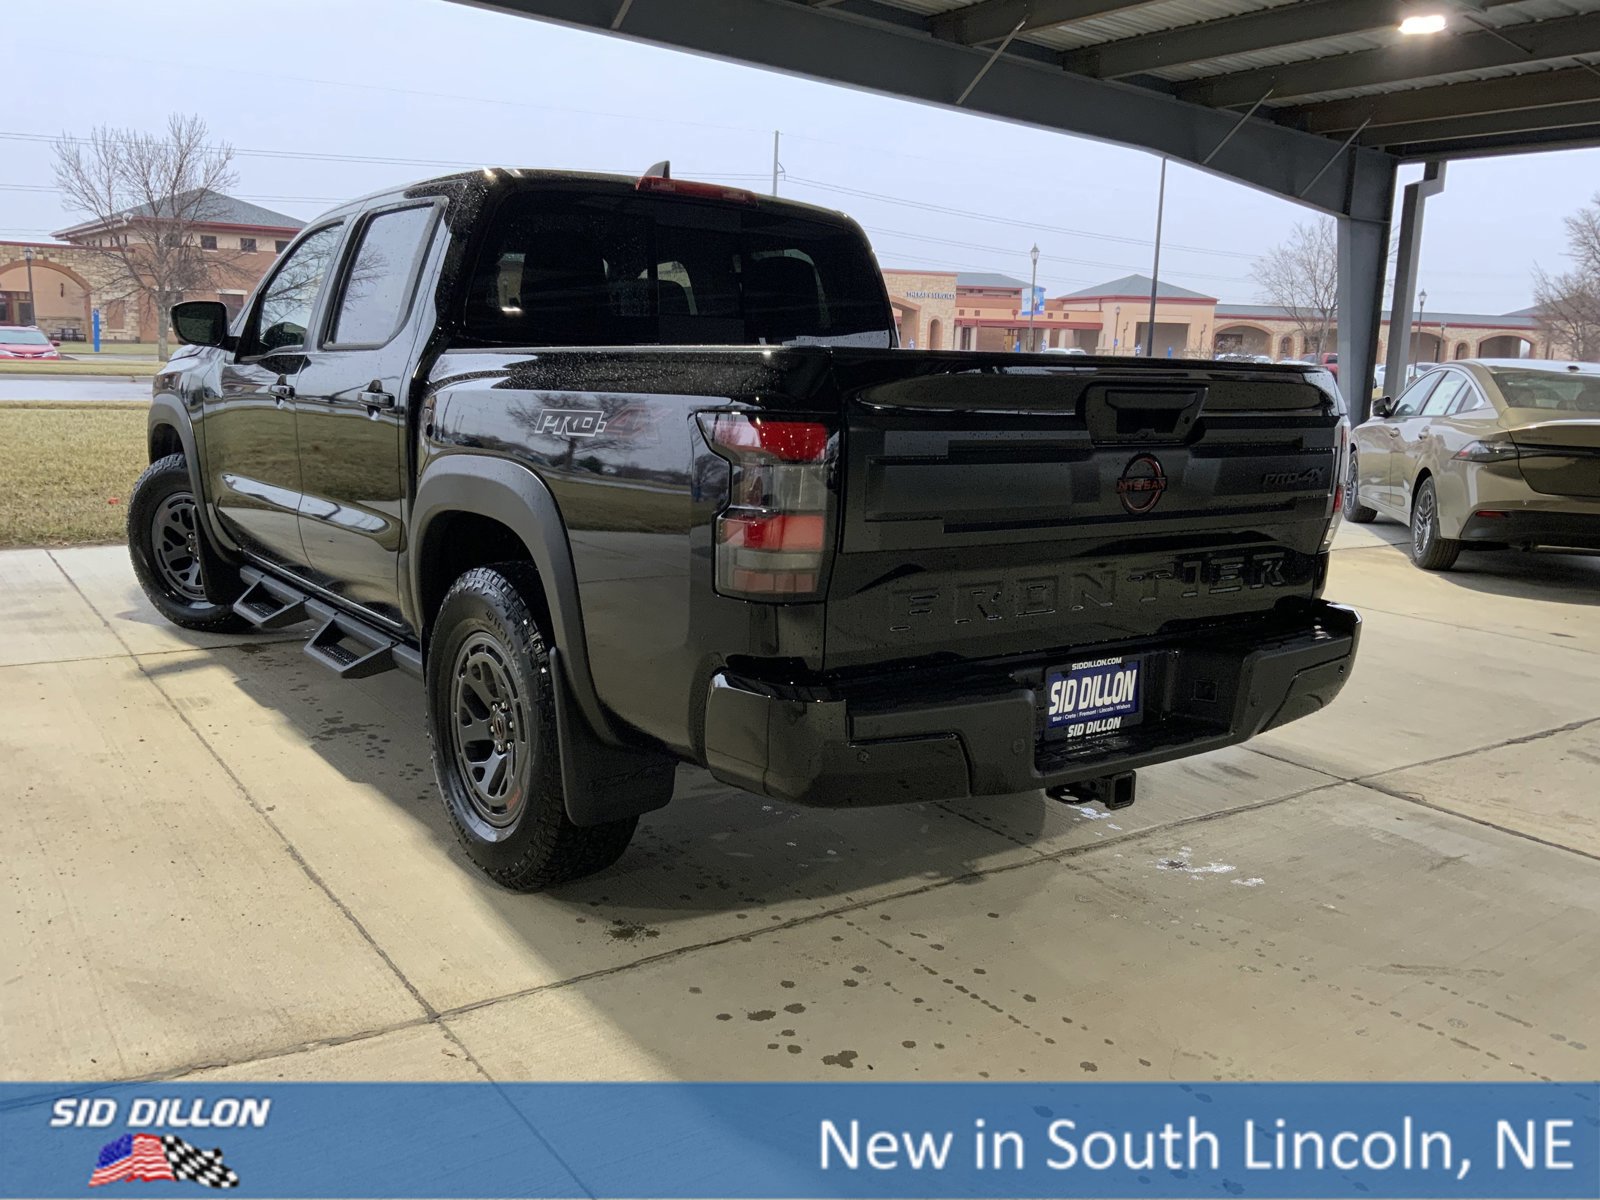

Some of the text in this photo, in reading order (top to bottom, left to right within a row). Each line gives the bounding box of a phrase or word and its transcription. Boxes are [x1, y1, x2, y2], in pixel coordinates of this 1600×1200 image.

[1117, 476, 1168, 493] NISSAN
[888, 551, 1289, 632] FRONTIER
[1071, 656, 1122, 671] SIDDILLON.COM
[1048, 669, 1137, 716] SID DILLON
[1067, 716, 1122, 738] SID DILLON
